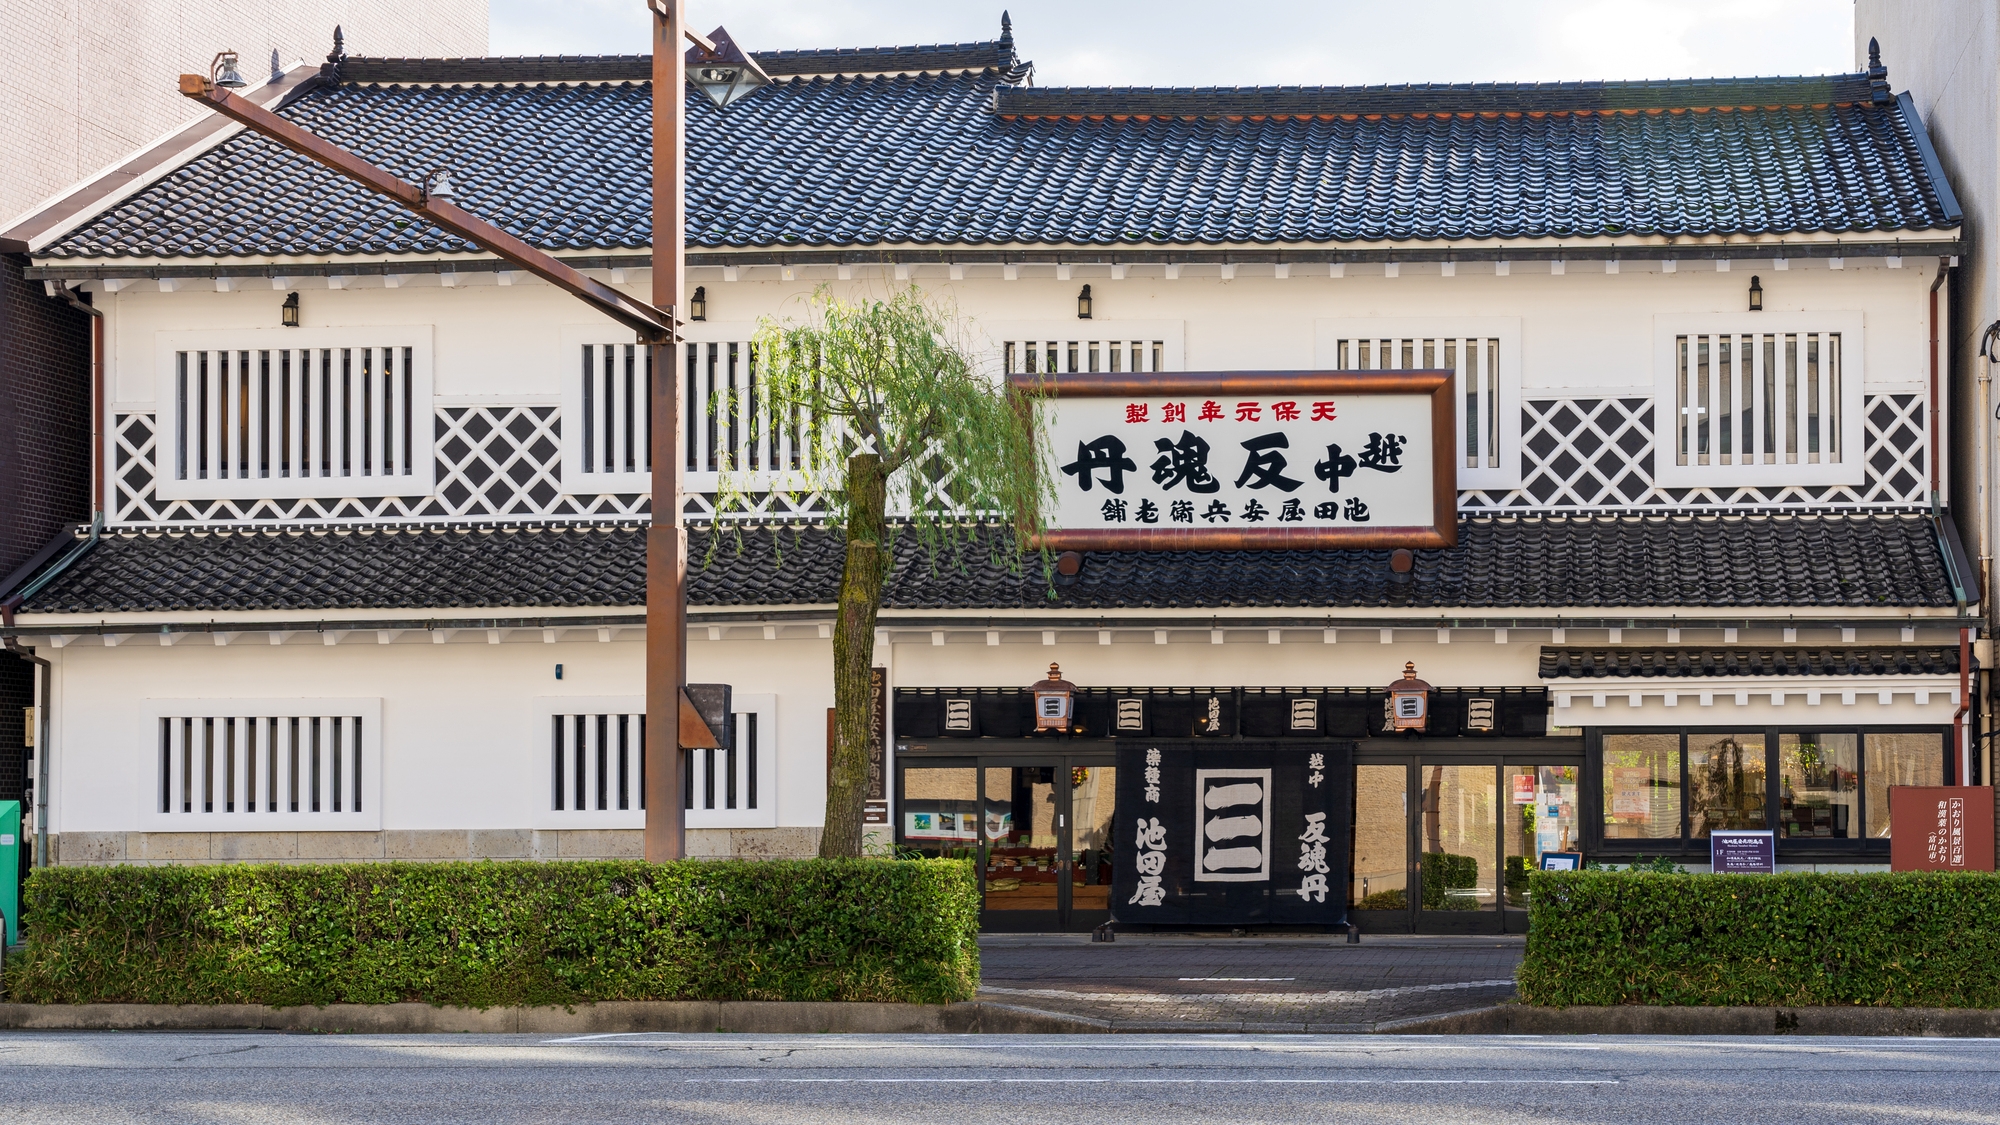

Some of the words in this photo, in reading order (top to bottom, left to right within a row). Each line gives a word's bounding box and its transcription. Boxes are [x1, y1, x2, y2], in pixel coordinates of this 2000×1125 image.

[1206, 697, 1220, 731] 池田屋
[1308, 753, 1325, 788] 越中
[1129, 817, 1167, 906] 池田屋
[1296, 812, 1330, 903] 反魂丹
[1937, 800, 1948, 864] 和漢薬のかおり
[1951, 800, 1962, 864] かおり風景百選
